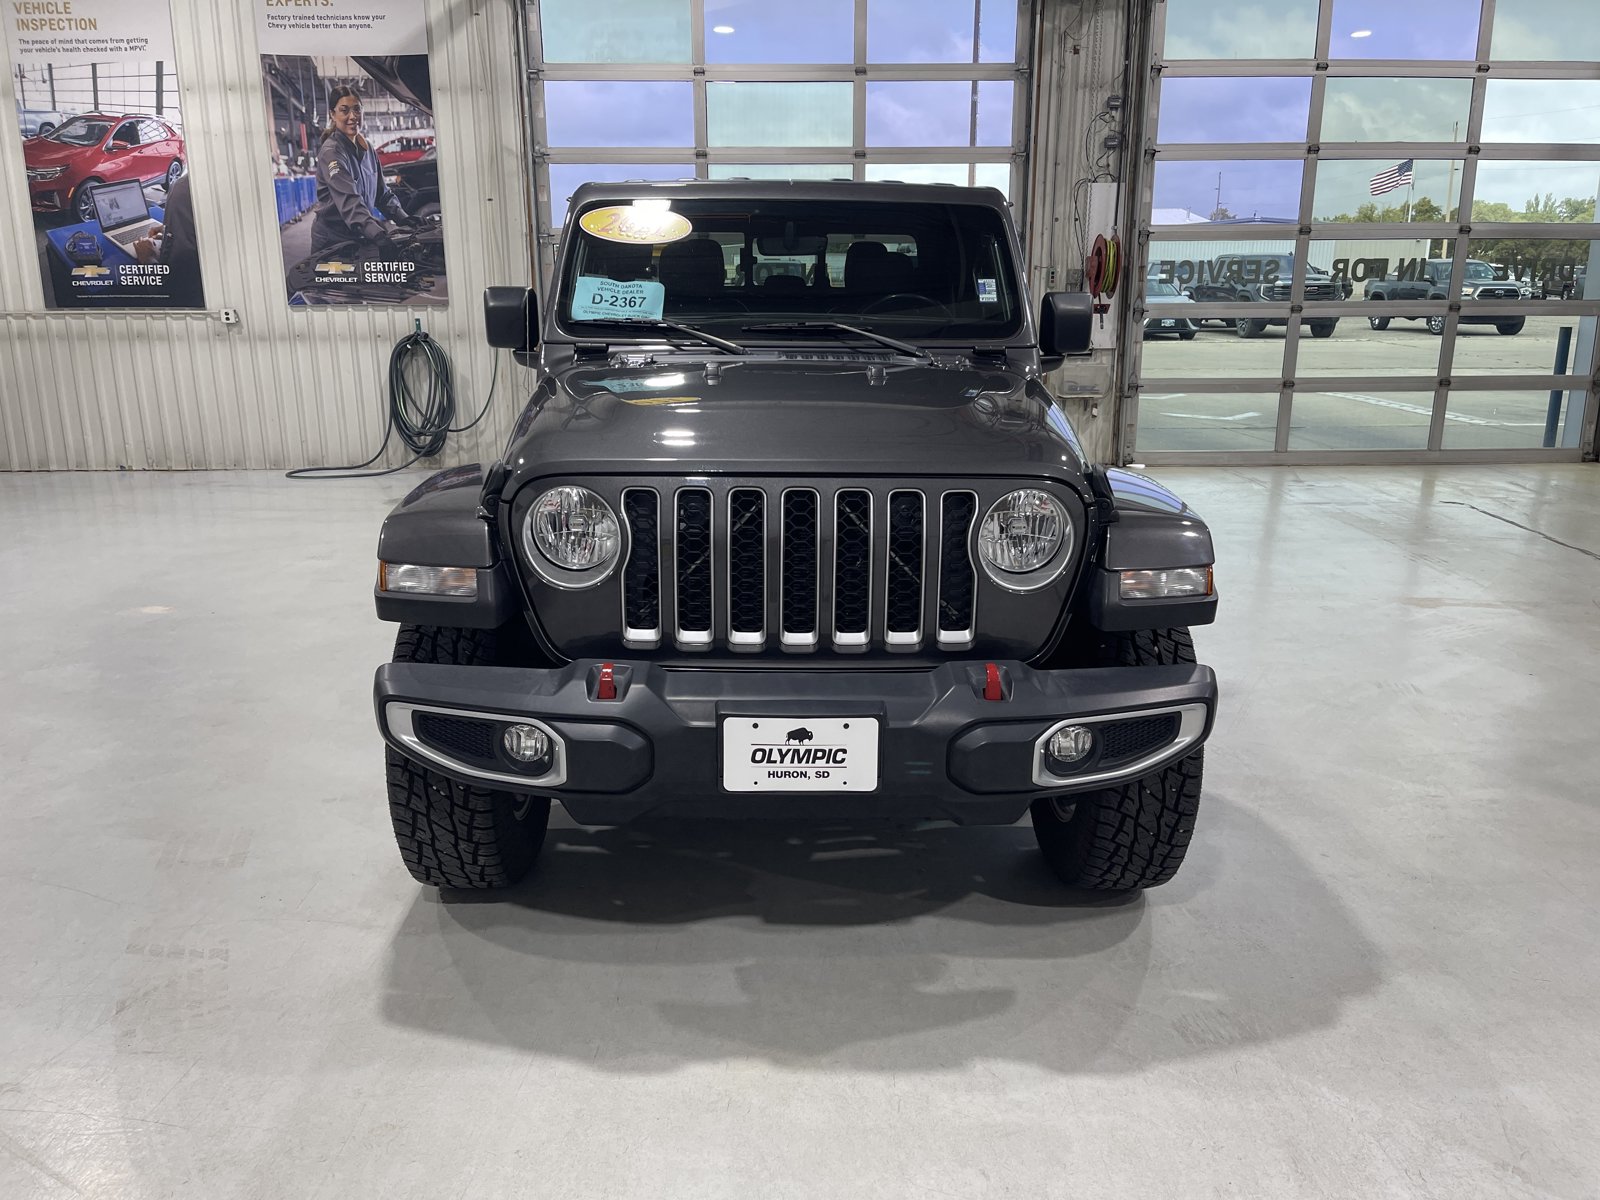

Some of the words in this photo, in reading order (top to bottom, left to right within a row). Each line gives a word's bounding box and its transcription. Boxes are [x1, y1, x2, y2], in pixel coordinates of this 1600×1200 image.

[13, 2, 72, 15] VEHICLE
[267, 14, 291, 22] Factory
[292, 13, 315, 21] trained
[316, 13, 352, 21] technicians
[353, 13, 371, 21] know
[371, 14, 386, 22] your
[16, 17, 97, 31] INSPECTION
[267, 22, 287, 30] Chevy
[126, 36, 149, 45] getting
[119, 264, 170, 275] CERTIFIED
[364, 262, 415, 272] CERTIFIED
[120, 275, 163, 286] SERVICE
[364, 272, 408, 283] SERVICE
[600, 281, 620, 289] SOUTH
[597, 286, 621, 295] VEHICLE
[591, 292, 647, 309] D-2367
[750, 748, 848, 765] OLYMPIC
[767, 770, 811, 780] HURON,
[814, 770, 830, 779] SD
